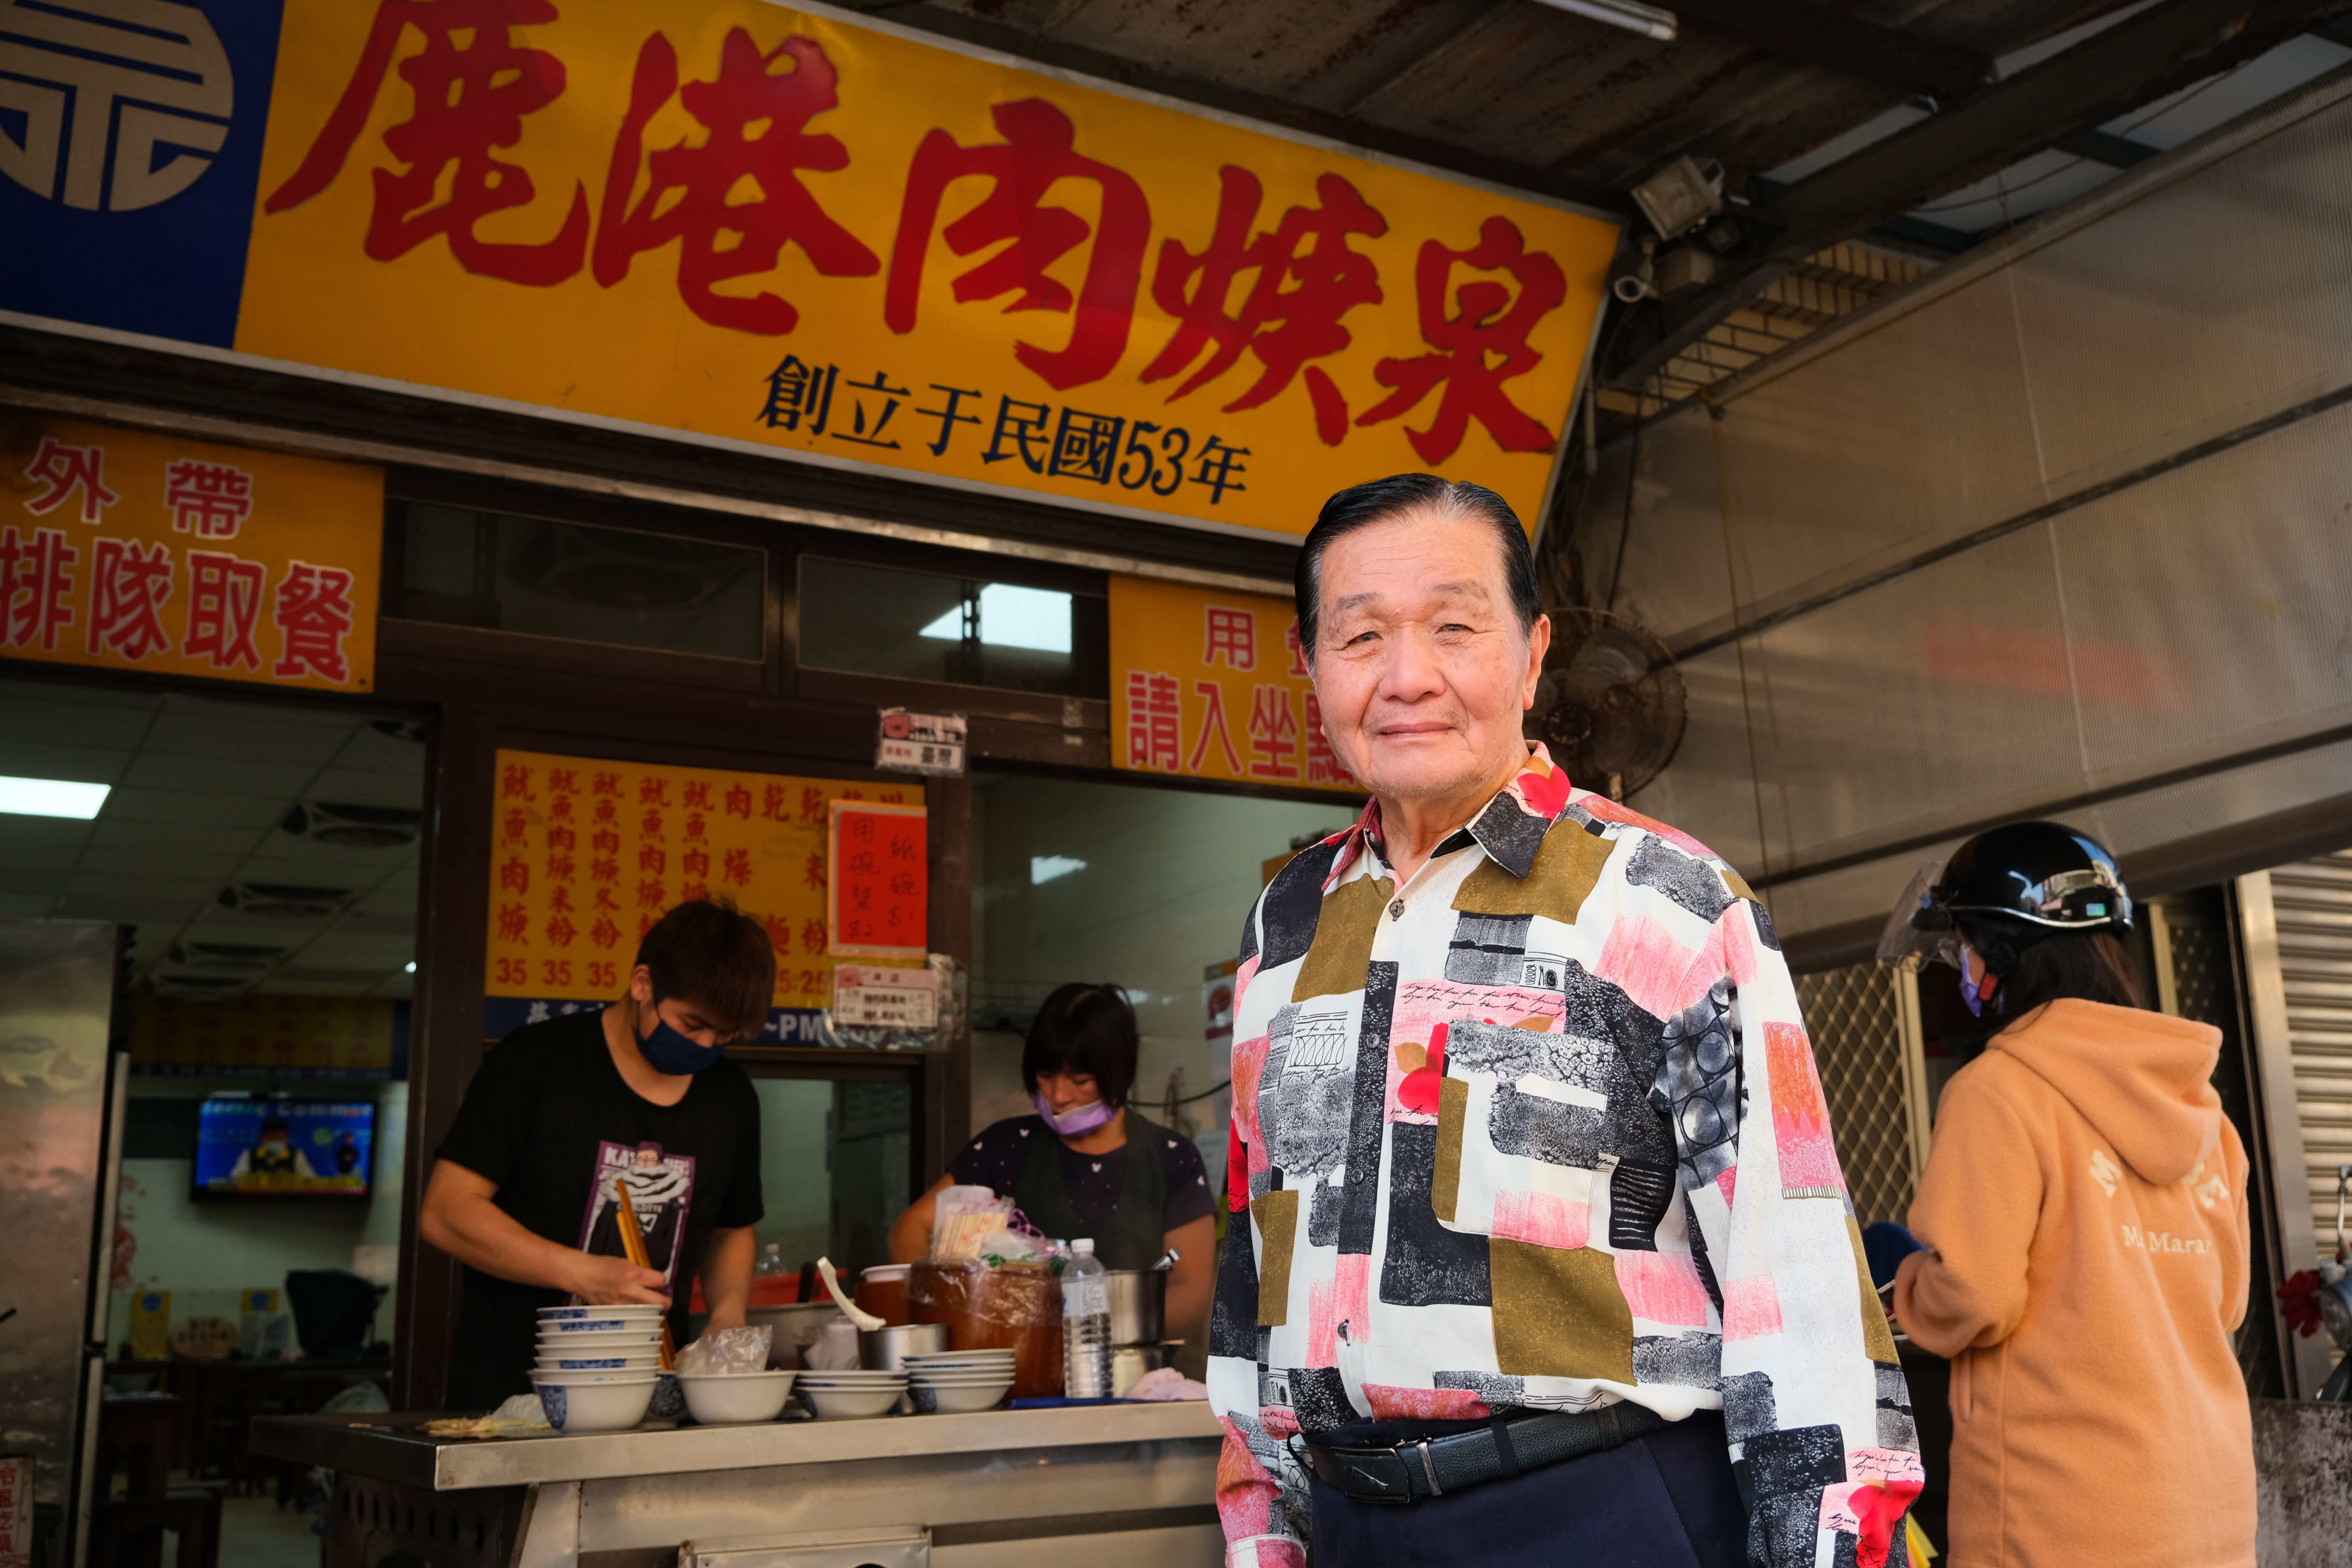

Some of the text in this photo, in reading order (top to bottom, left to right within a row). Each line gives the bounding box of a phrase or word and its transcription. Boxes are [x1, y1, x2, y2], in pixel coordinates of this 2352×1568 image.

[755, 354, 1251, 504] 創立于民國53年
[24, 436, 253, 539] 外帶
[0, 526, 355, 684] 排隊取餐
[497, 958, 527, 985] 35
[543, 959, 572, 986] 35
[588, 961, 617, 988] 35
